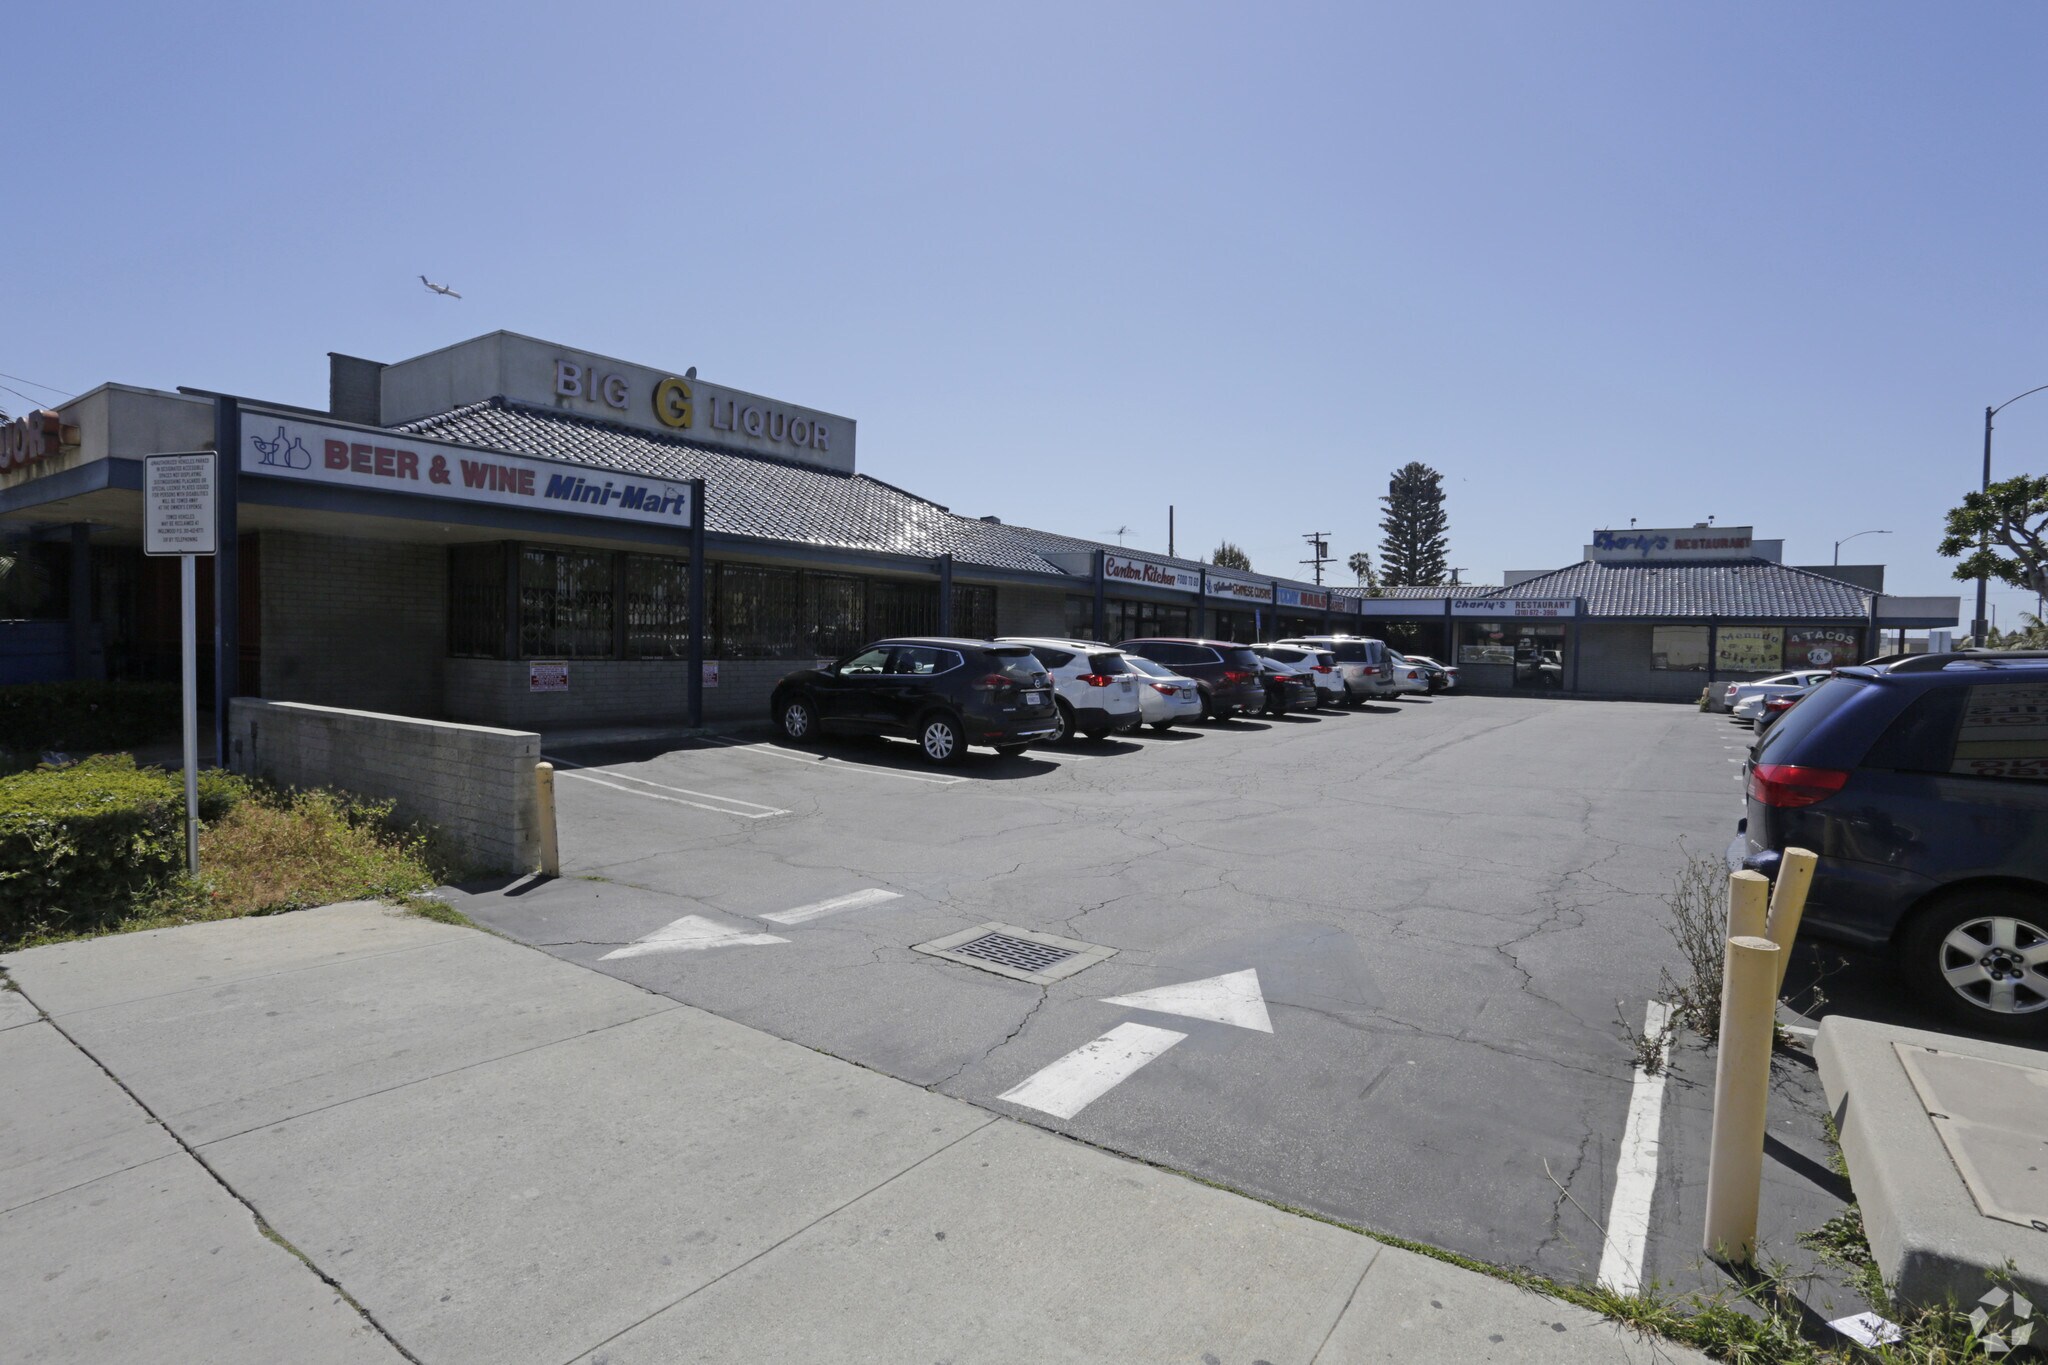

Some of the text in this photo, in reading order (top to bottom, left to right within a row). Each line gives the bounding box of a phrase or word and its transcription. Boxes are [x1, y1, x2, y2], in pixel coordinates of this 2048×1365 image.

[555, 359, 831, 451] BIG G LIQUOR
[324, 439, 686, 516] BEER & WINE Mini-Mart
[1105, 557, 1142, 581] Canton
[1142, 563, 1176, 586] Kitchen
[1515, 601, 1570, 609] RESTAURANT
[1721, 632, 1779, 643] Menudo
[1802, 631, 1856, 644] TACOS
